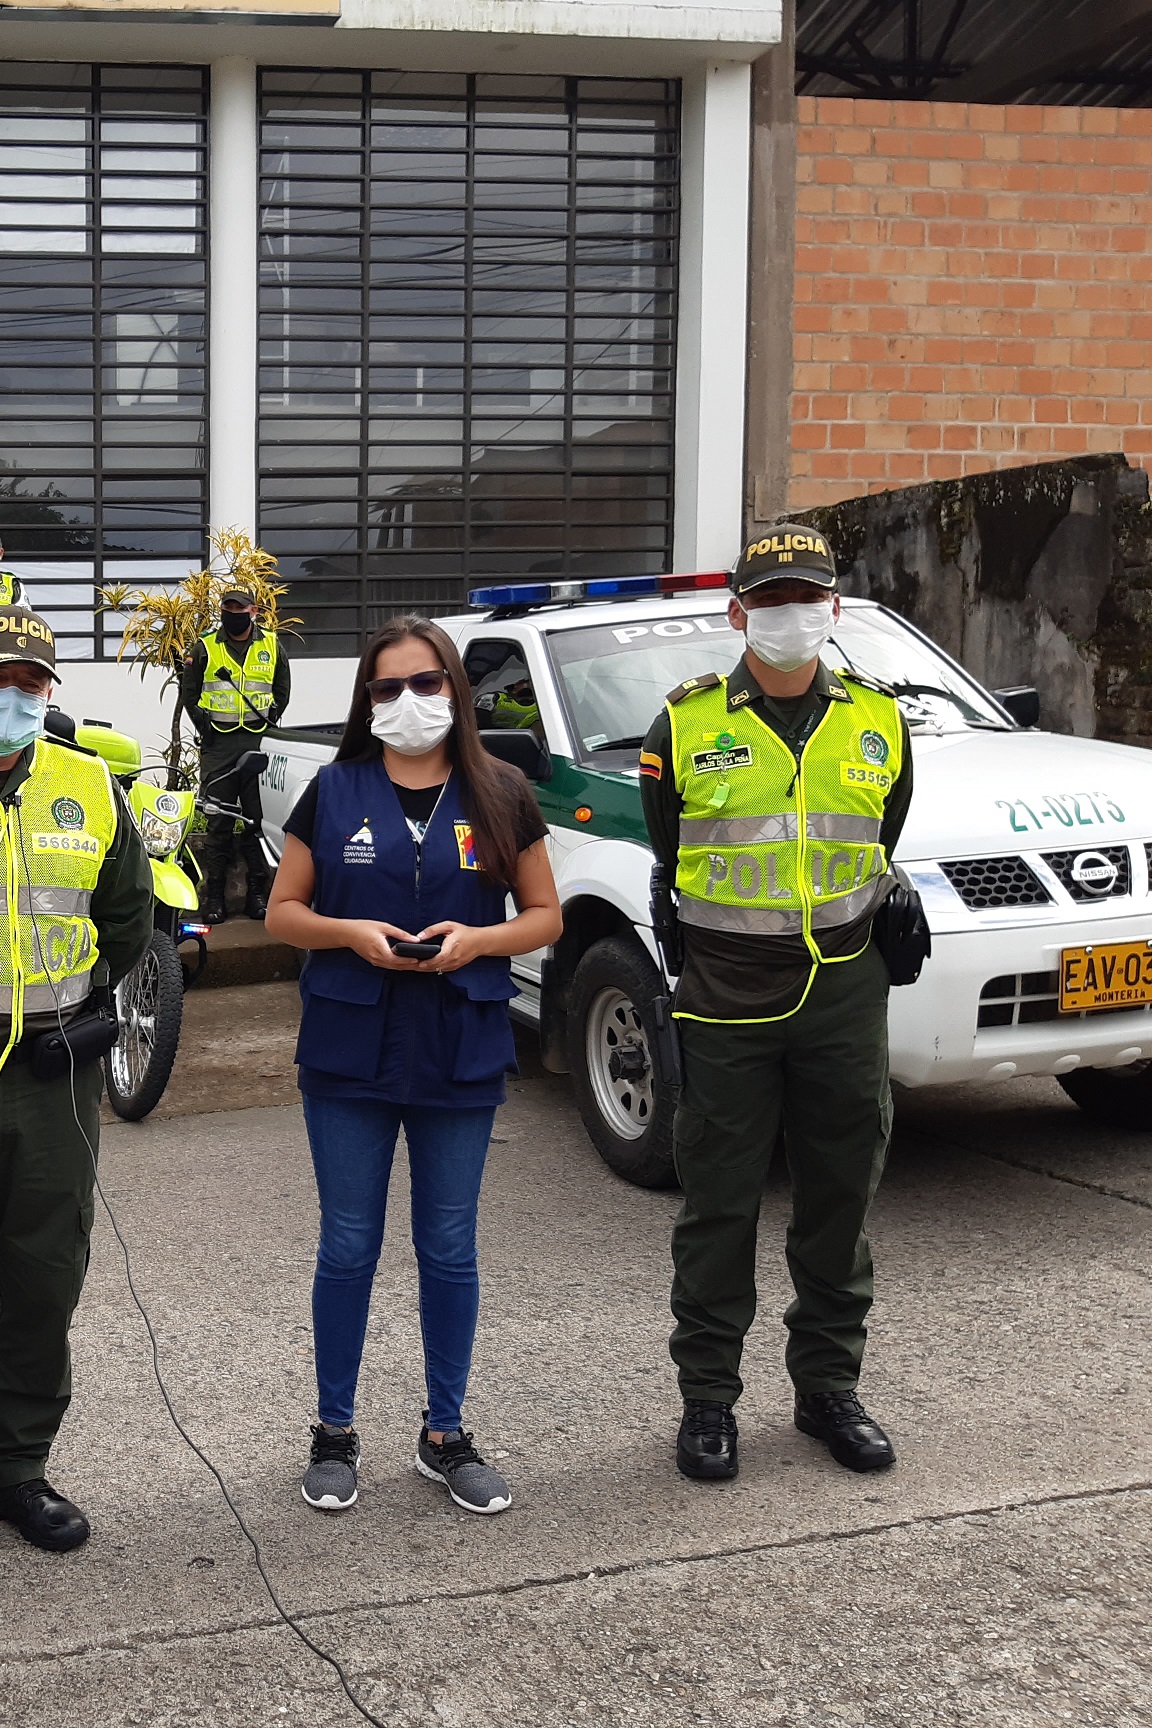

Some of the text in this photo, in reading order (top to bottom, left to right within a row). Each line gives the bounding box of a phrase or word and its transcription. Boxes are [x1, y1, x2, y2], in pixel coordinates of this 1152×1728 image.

[746, 534, 827, 562] POLICIA
[995, 791, 1126, 833] 21-0273
[37, 836, 97, 854] 566344
[706, 846, 883, 899] POLICIA
[1079, 869, 1116, 879] NISSAN
[1094, 988, 1146, 1003] MONTERIA
